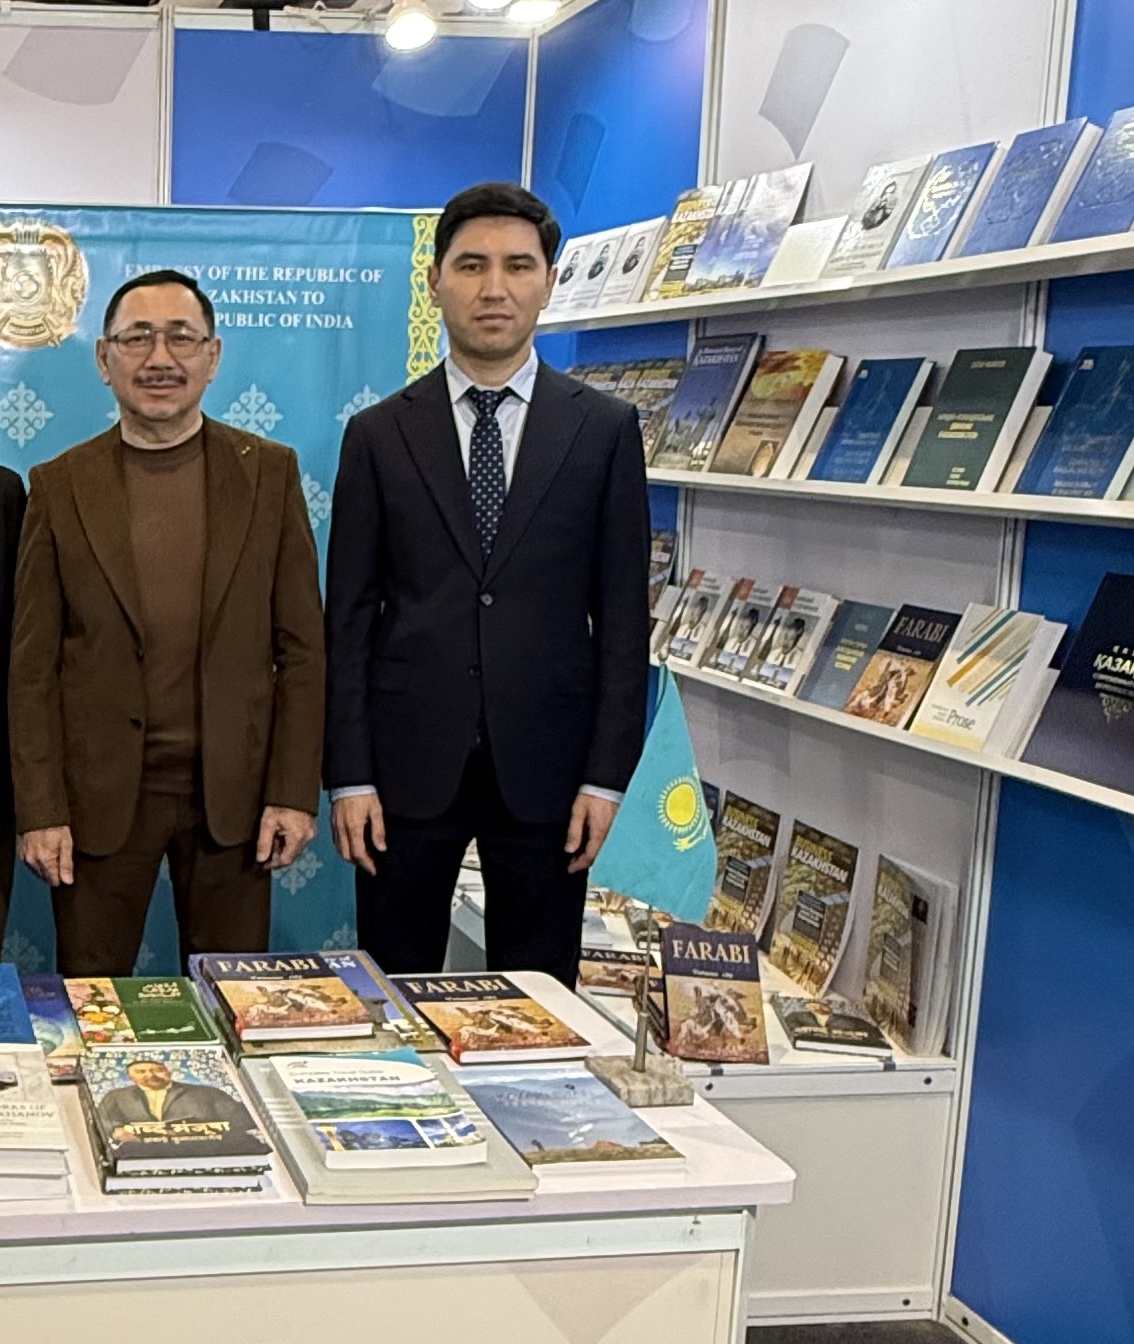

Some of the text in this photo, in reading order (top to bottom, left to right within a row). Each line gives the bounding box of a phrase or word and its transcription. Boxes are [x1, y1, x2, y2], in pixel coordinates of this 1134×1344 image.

[208, 266, 230, 280] OF
[235, 267, 269, 281] THE
[272, 267, 358, 283] REPUBLIC
[360, 268, 384, 284] OF
[301, 290, 325, 305] TO
[278, 313, 303, 328] OF
[306, 313, 354, 330] INDIA
[893, 616, 950, 644] FARABI
[946, 709, 976, 731] Prose
[672, 939, 751, 964] FARABI
[216, 958, 321, 973] FARABI
[404, 978, 511, 994] FARABI
